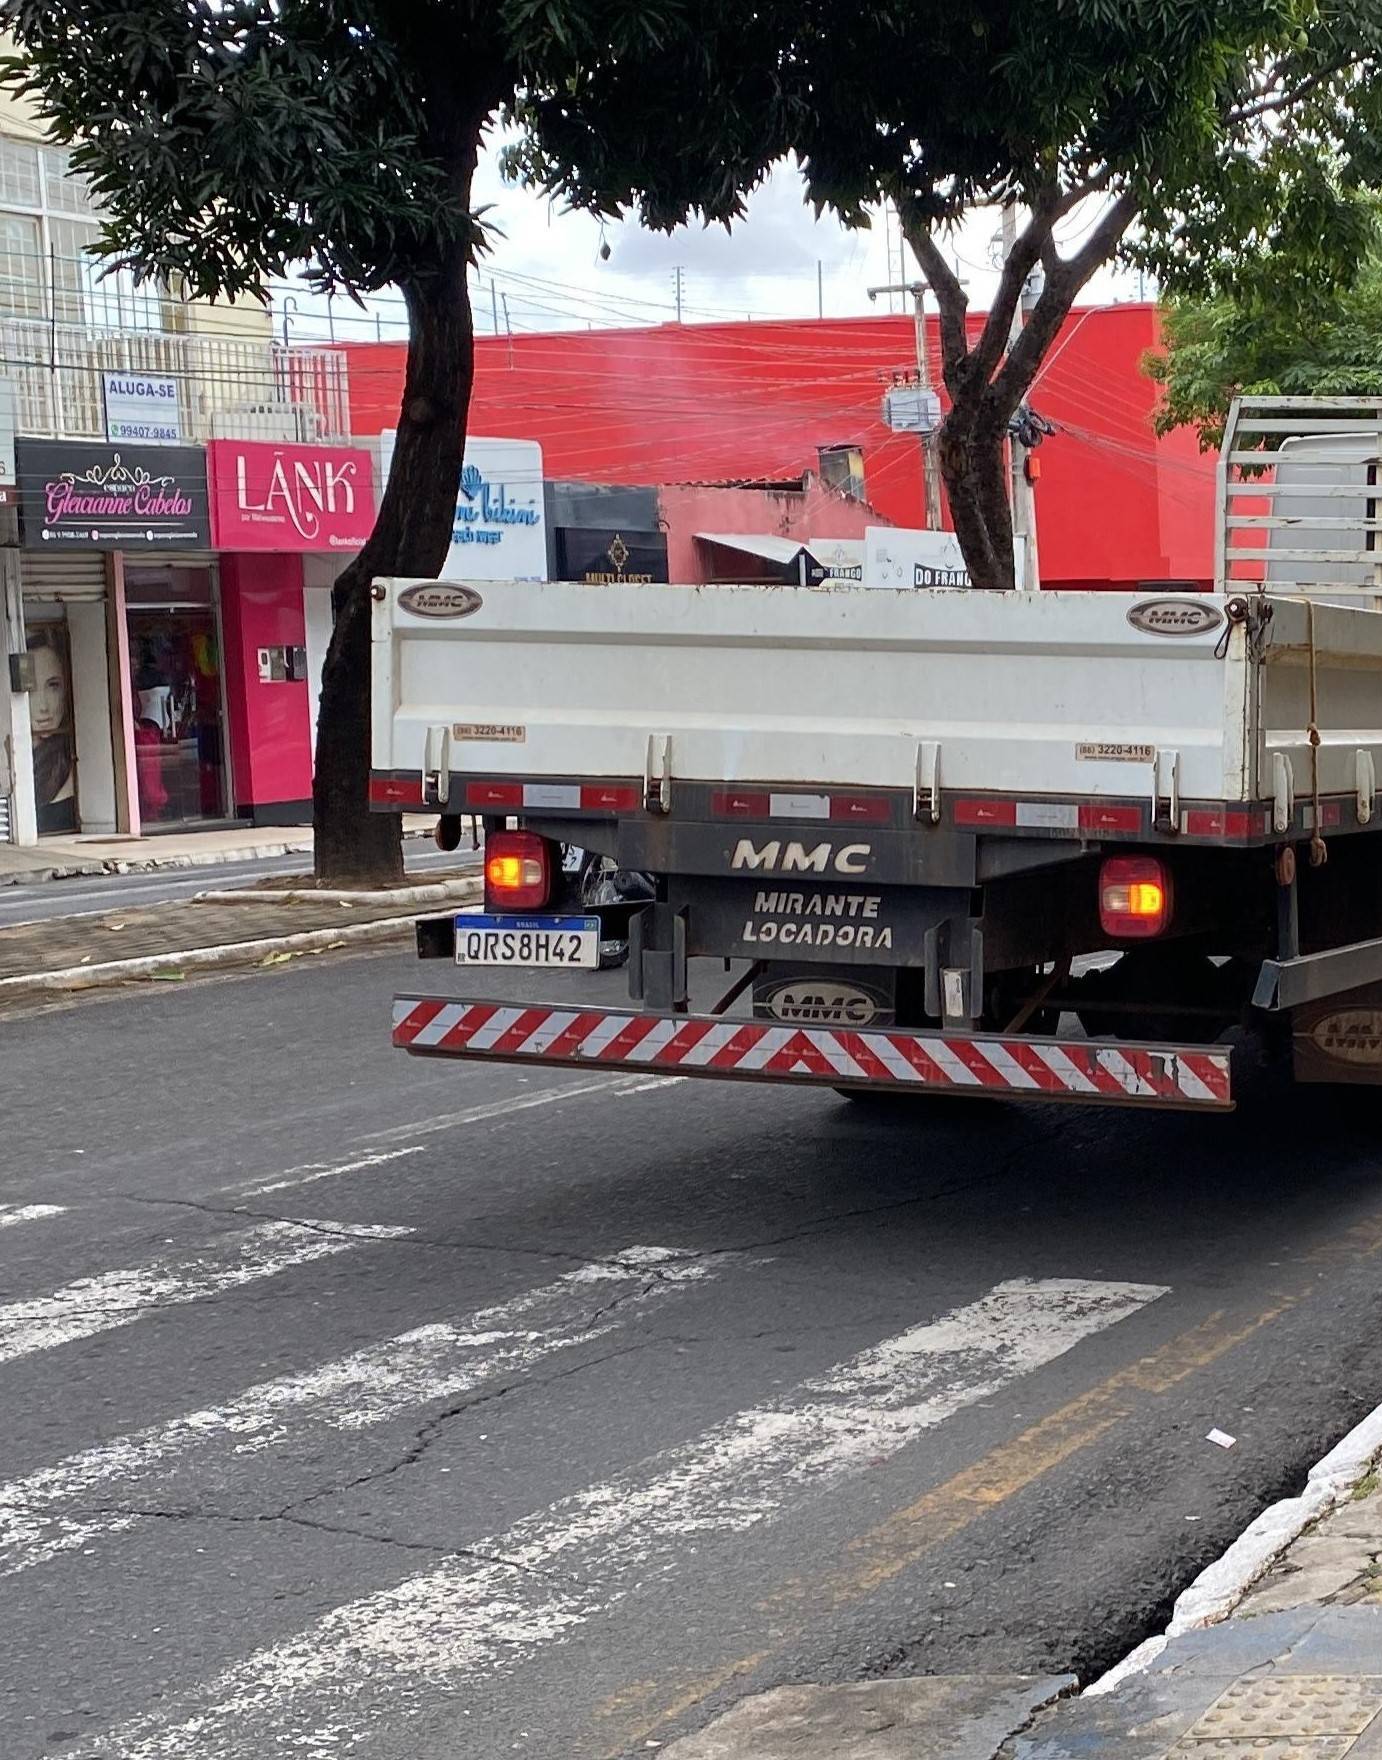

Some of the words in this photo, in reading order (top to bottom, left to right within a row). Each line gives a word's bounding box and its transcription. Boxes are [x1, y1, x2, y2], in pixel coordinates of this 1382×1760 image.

[109, 380, 175, 398] ALUGA-SE
[134, 485, 192, 516] Cabelos
[829, 567, 862, 580] FRANGO
[915, 567, 931, 585] DO
[934, 570, 972, 587] FRANG
[1098, 743, 1152, 757] 3220-4116
[731, 838, 871, 874] MMC
[754, 891, 882, 918] MIRANTE
[467, 932, 582, 963] QRS8H42
[743, 920, 893, 949] LOCADORA
[781, 994, 867, 1021] MMC
